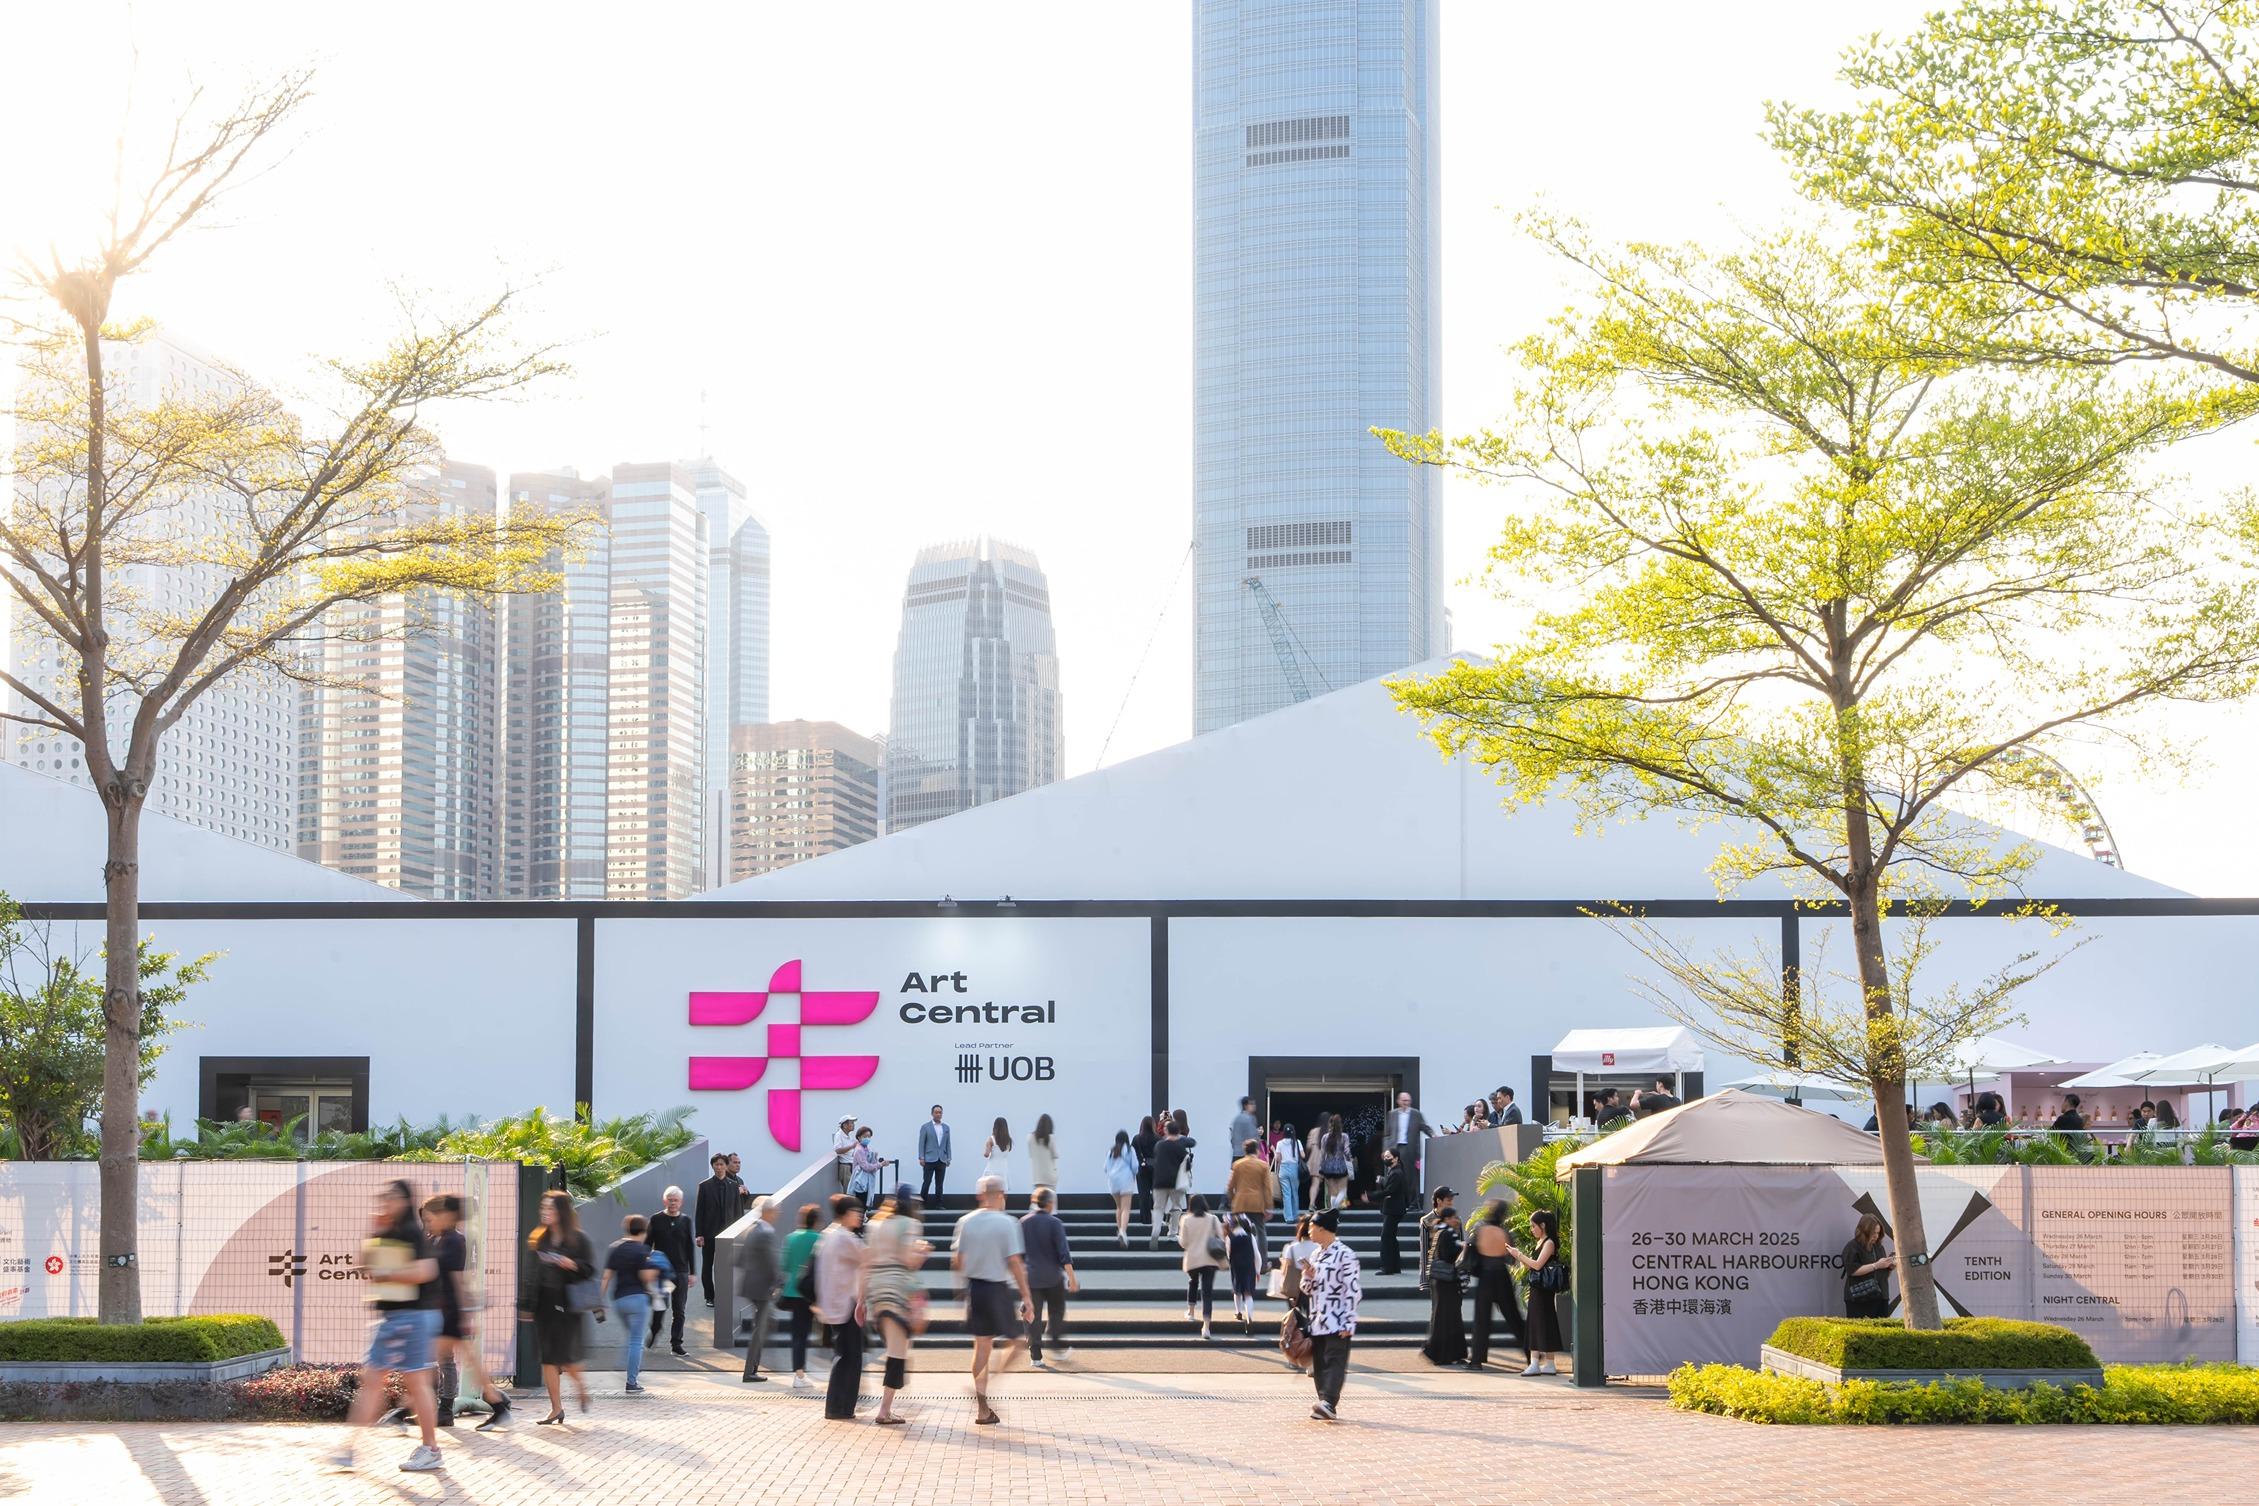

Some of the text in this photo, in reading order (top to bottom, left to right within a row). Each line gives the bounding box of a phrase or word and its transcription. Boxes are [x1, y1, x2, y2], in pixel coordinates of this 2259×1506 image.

[900, 971, 967, 993] Art
[899, 1000, 1055, 1024] Central
[989, 1056, 1055, 1081] UOB
[2041, 1210, 2085, 1219] GENERAL
[2088, 1210, 2132, 1219] OPENING
[2134, 1210, 2167, 1219] HOURS
[1692, 1232, 1753, 1246] MARCH
[1759, 1232, 1800, 1246] 2025
[319, 1254, 353, 1265] Art
[1632, 1254, 1717, 1269] CENTRAL
[1964, 1256, 2002, 1266] TENTH
[1633, 1275, 1749, 1290] HONG KONG
[1965, 1271, 2011, 1281] EDITION
[1632, 1298, 1732, 1315] 香港中環海濱
[2043, 1296, 2120, 1304] NIGHT CENTRAL
